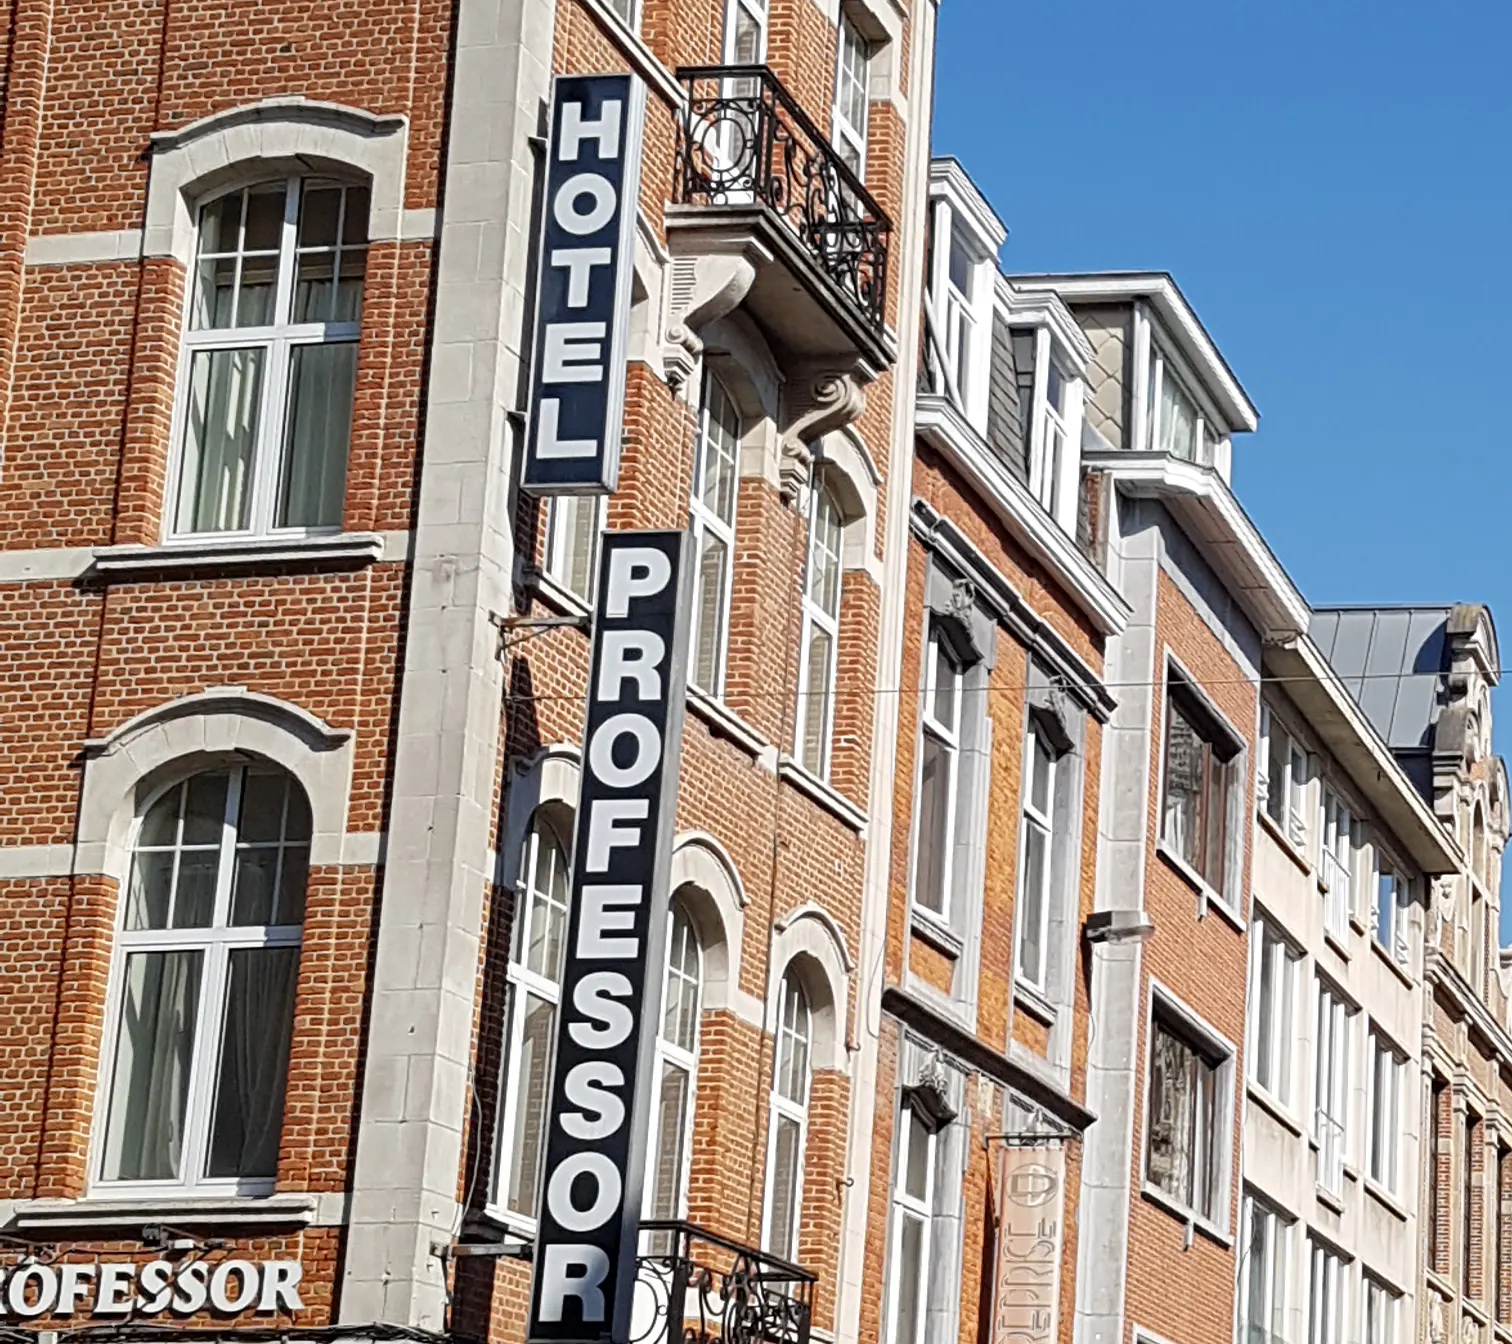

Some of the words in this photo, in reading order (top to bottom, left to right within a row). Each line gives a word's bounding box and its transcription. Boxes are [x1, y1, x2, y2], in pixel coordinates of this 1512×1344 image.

[535, 99, 622, 460] HOTEL
[537, 546, 672, 1324] PROFESSOR
[0, 1259, 305, 1316] OFESSOR
